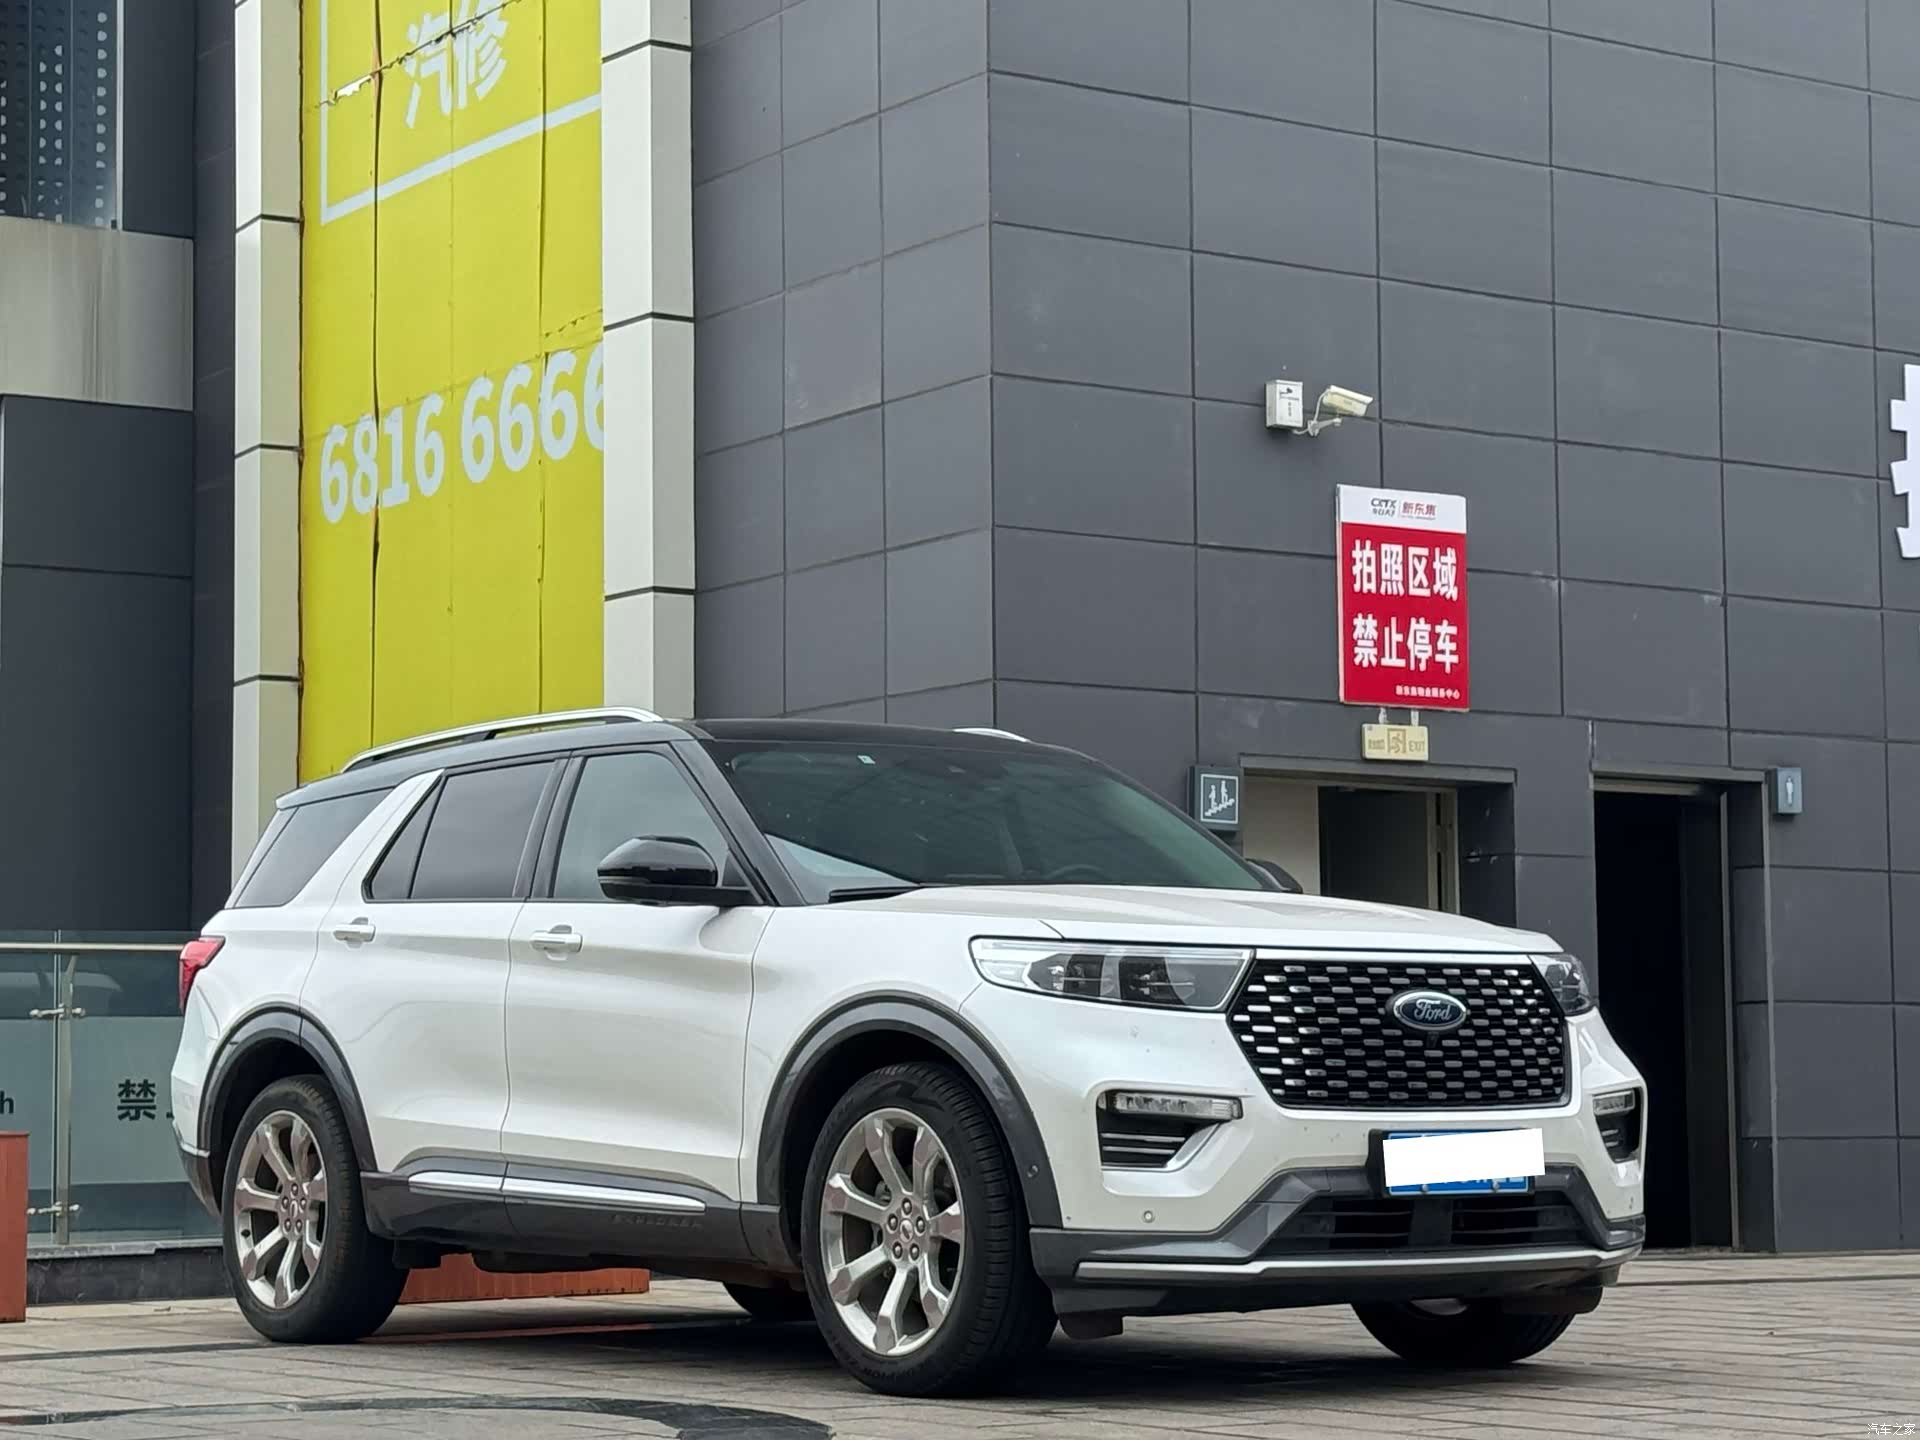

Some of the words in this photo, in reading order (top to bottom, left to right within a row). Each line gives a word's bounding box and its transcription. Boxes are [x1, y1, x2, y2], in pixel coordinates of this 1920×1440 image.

[404, 0, 508, 129] 汽修
[320, 392, 445, 525] 6816
[1351, 539, 1459, 602] 拍照区域
[1352, 612, 1460, 674] 禁止停车
[1413, 998, 1452, 1020] Ford
[117, 1079, 174, 1121] 禁
